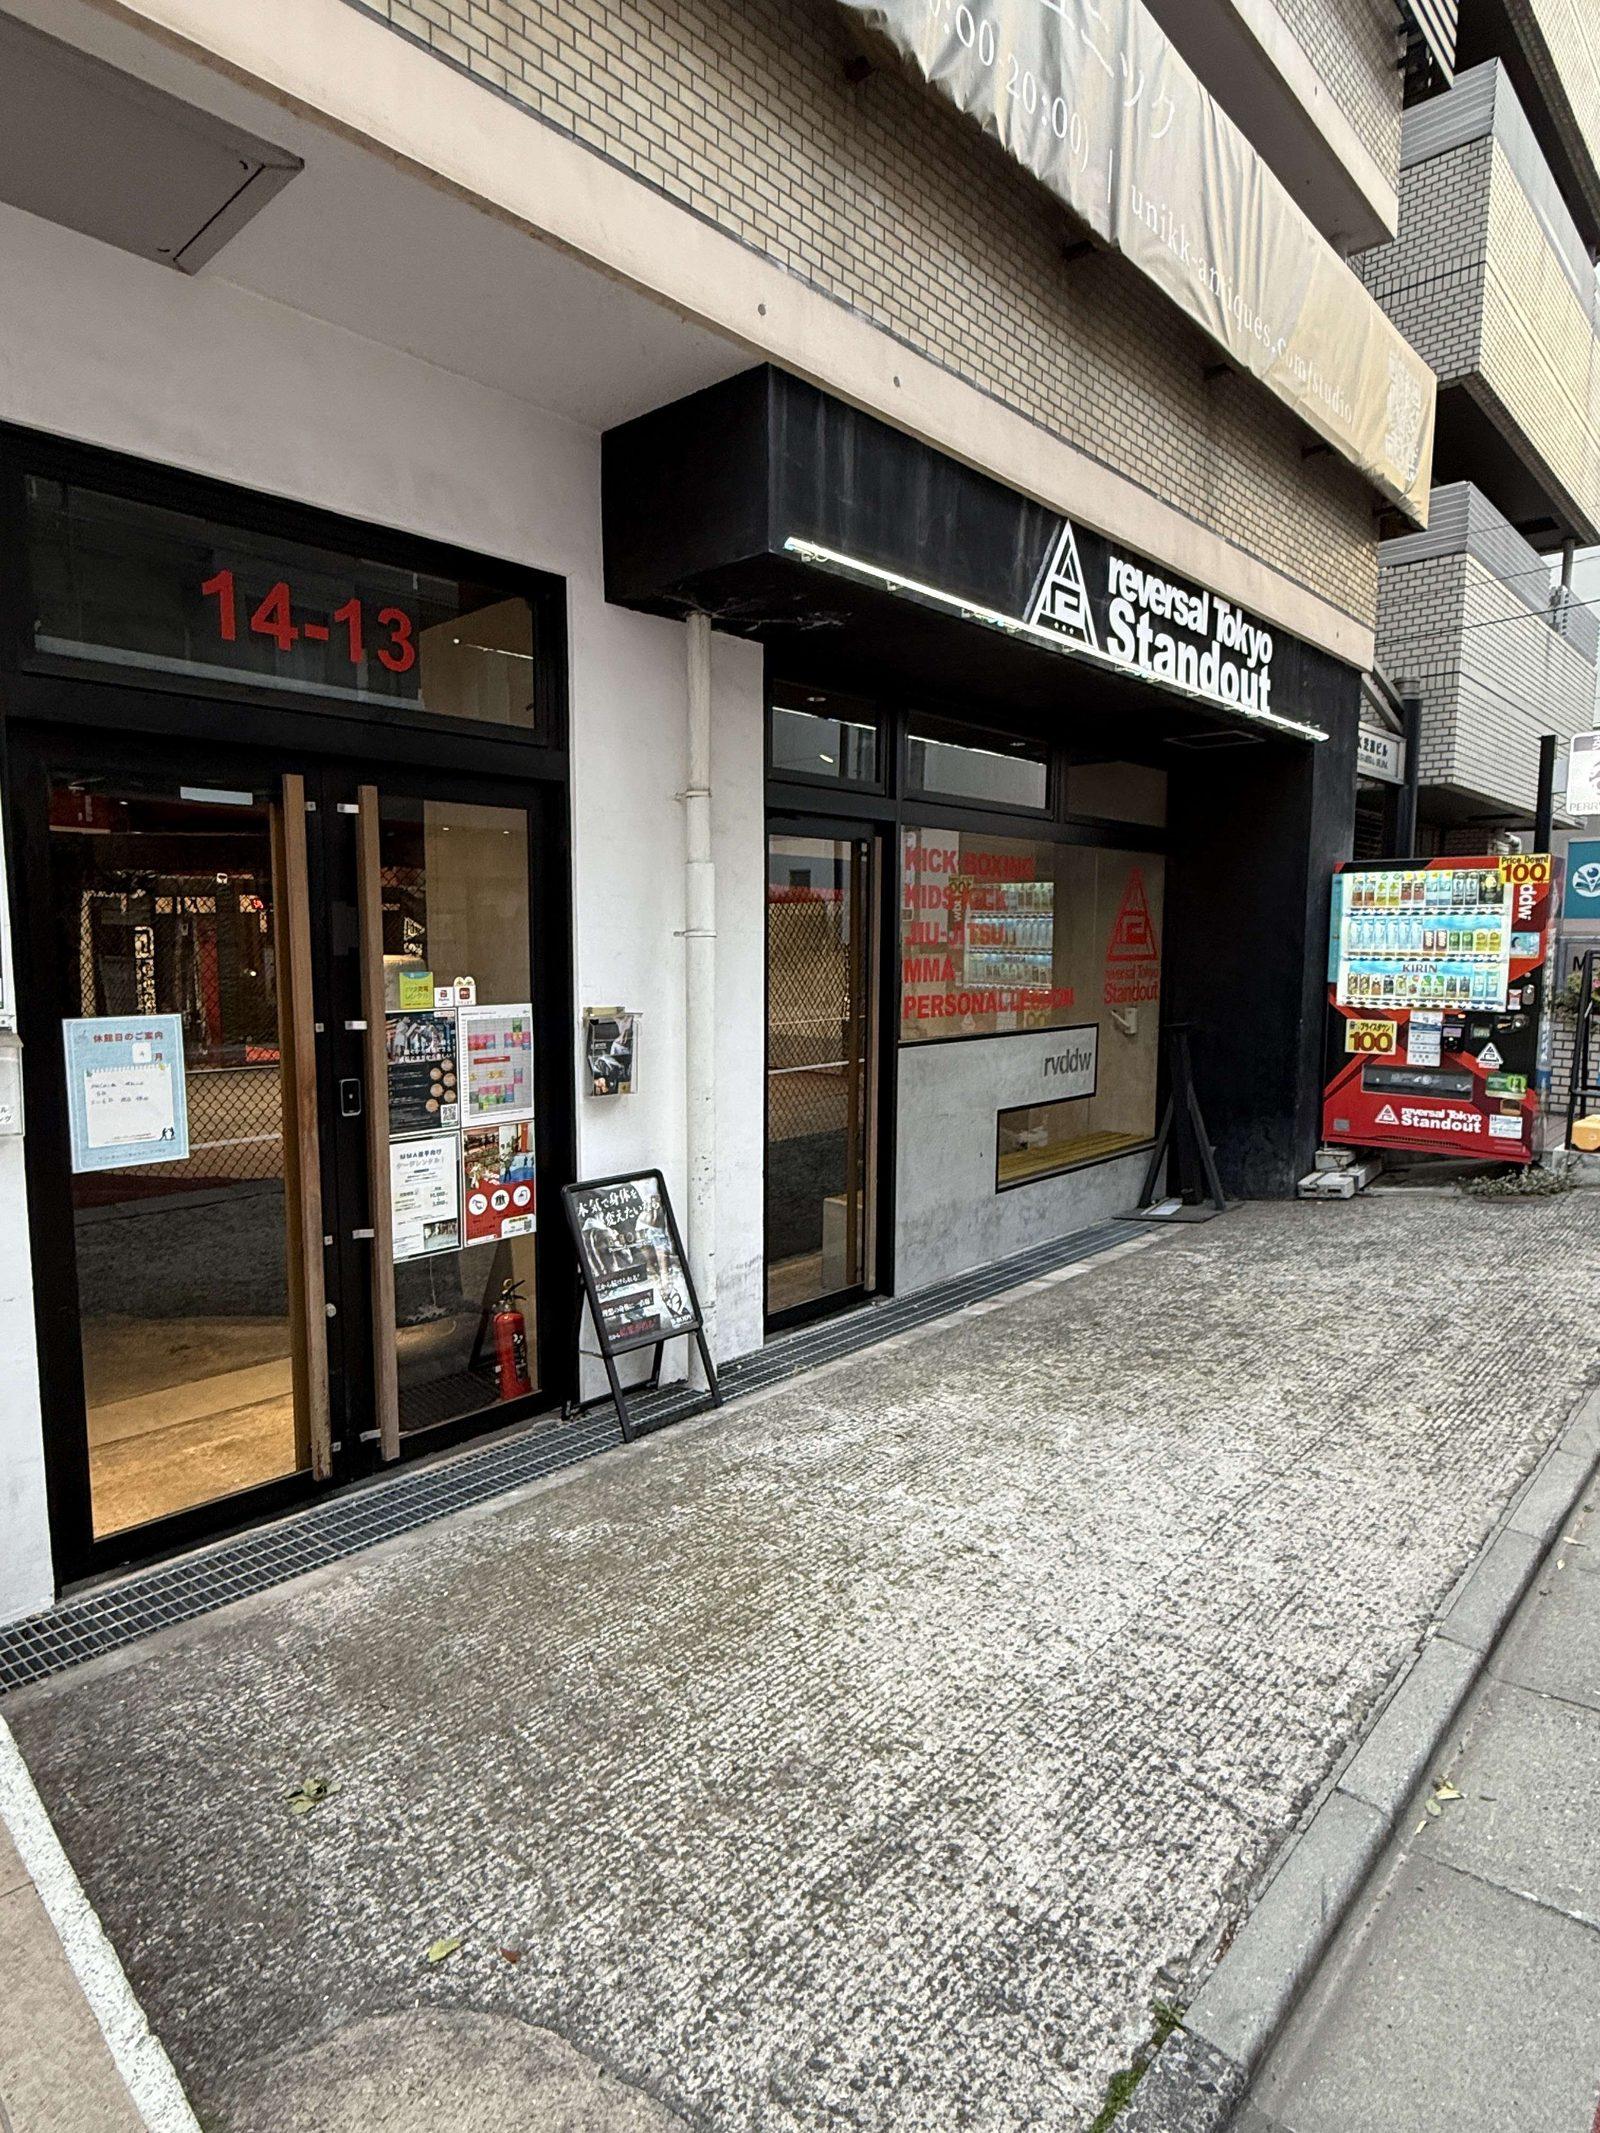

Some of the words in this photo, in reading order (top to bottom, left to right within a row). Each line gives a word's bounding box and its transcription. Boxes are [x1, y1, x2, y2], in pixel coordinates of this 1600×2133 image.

[201, 569, 417, 673] 14-13
[1108, 556, 1209, 635] reversal
[1213, 598, 1273, 668] Tokyo
[1107, 597, 1271, 712] Standout
[1569, 802, 1600, 812] PERR
[904, 846, 958, 874] KICK
[1502, 857, 1522, 865] Price
[1502, 863, 1547, 882] 100
[903, 956, 956, 984] MMA
[1402, 963, 1438, 974] KIRIN
[903, 990, 1010, 1020] PERSONAL
[1104, 981, 1159, 1004] Standout
[93, 1031, 164, 1043] 休館日のご案内
[1350, 1031, 1393, 1053] 100
[1043, 1047, 1093, 1077] rvddw
[1401, 1107, 1445, 1119] reversal
[1447, 1109, 1482, 1124] Tokyo
[1401, 1115, 1482, 1134] Standout
[577, 1188, 638, 1218] 本気で身体を
[605, 1200, 661, 1227] 変えたいなら
